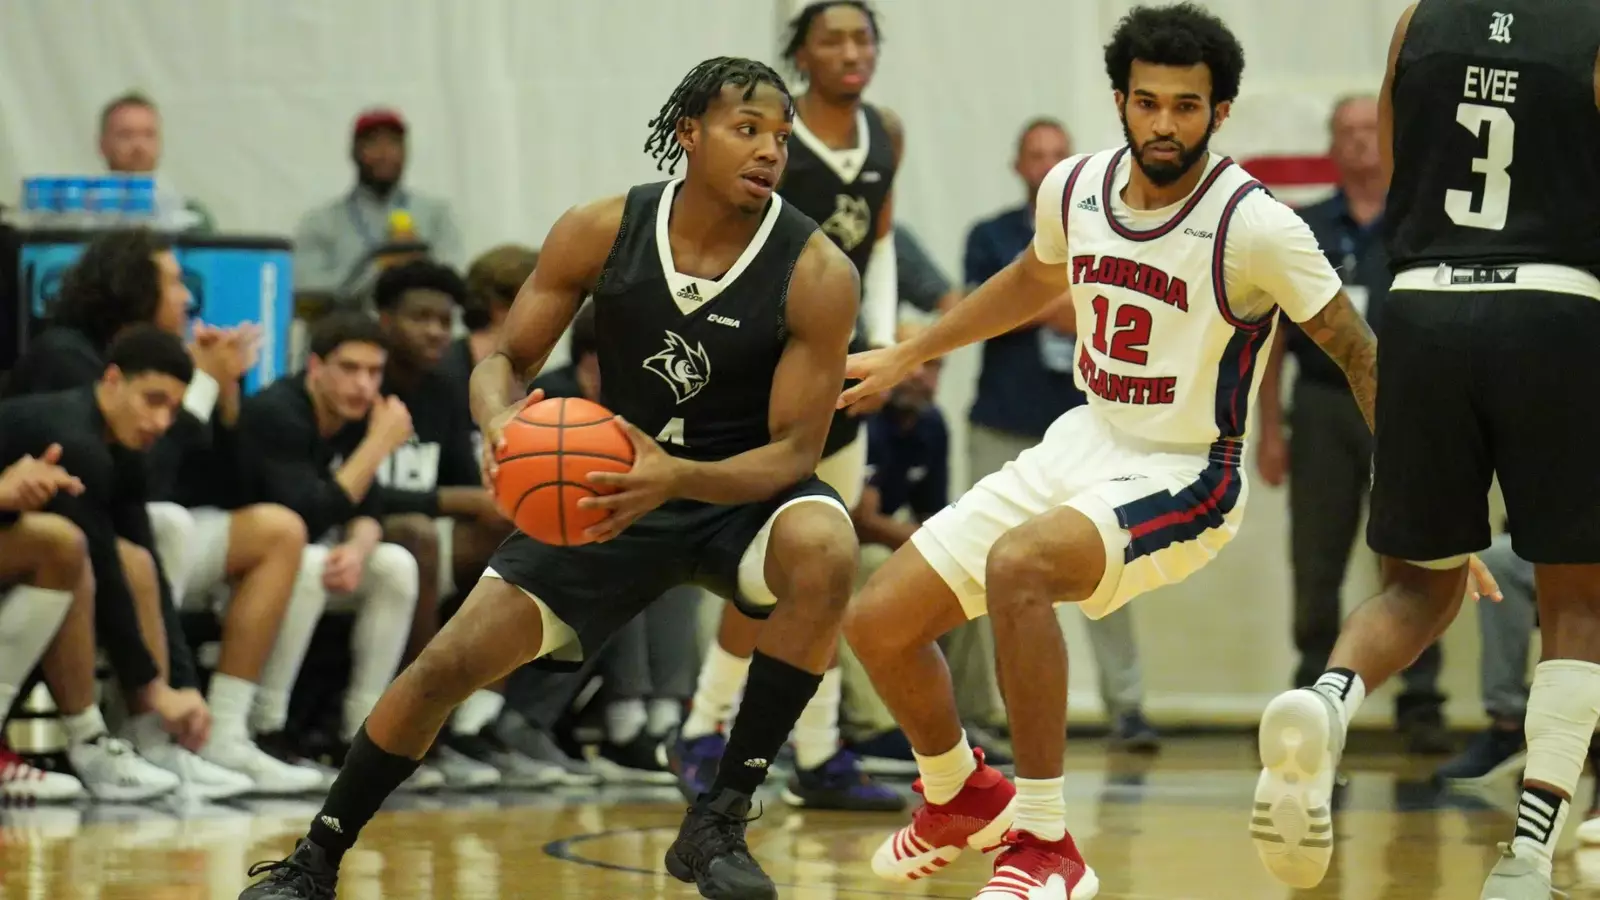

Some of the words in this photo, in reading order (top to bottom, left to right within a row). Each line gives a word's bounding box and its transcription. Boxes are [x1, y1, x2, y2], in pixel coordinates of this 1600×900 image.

[1463, 65, 1519, 103] EVEE
[1444, 102, 1515, 231] 3
[1077, 203, 1099, 212] adidas
[676, 291, 703, 302] adidas
[1072, 255, 1189, 313] FLORIDA
[1091, 294, 1153, 366] 12
